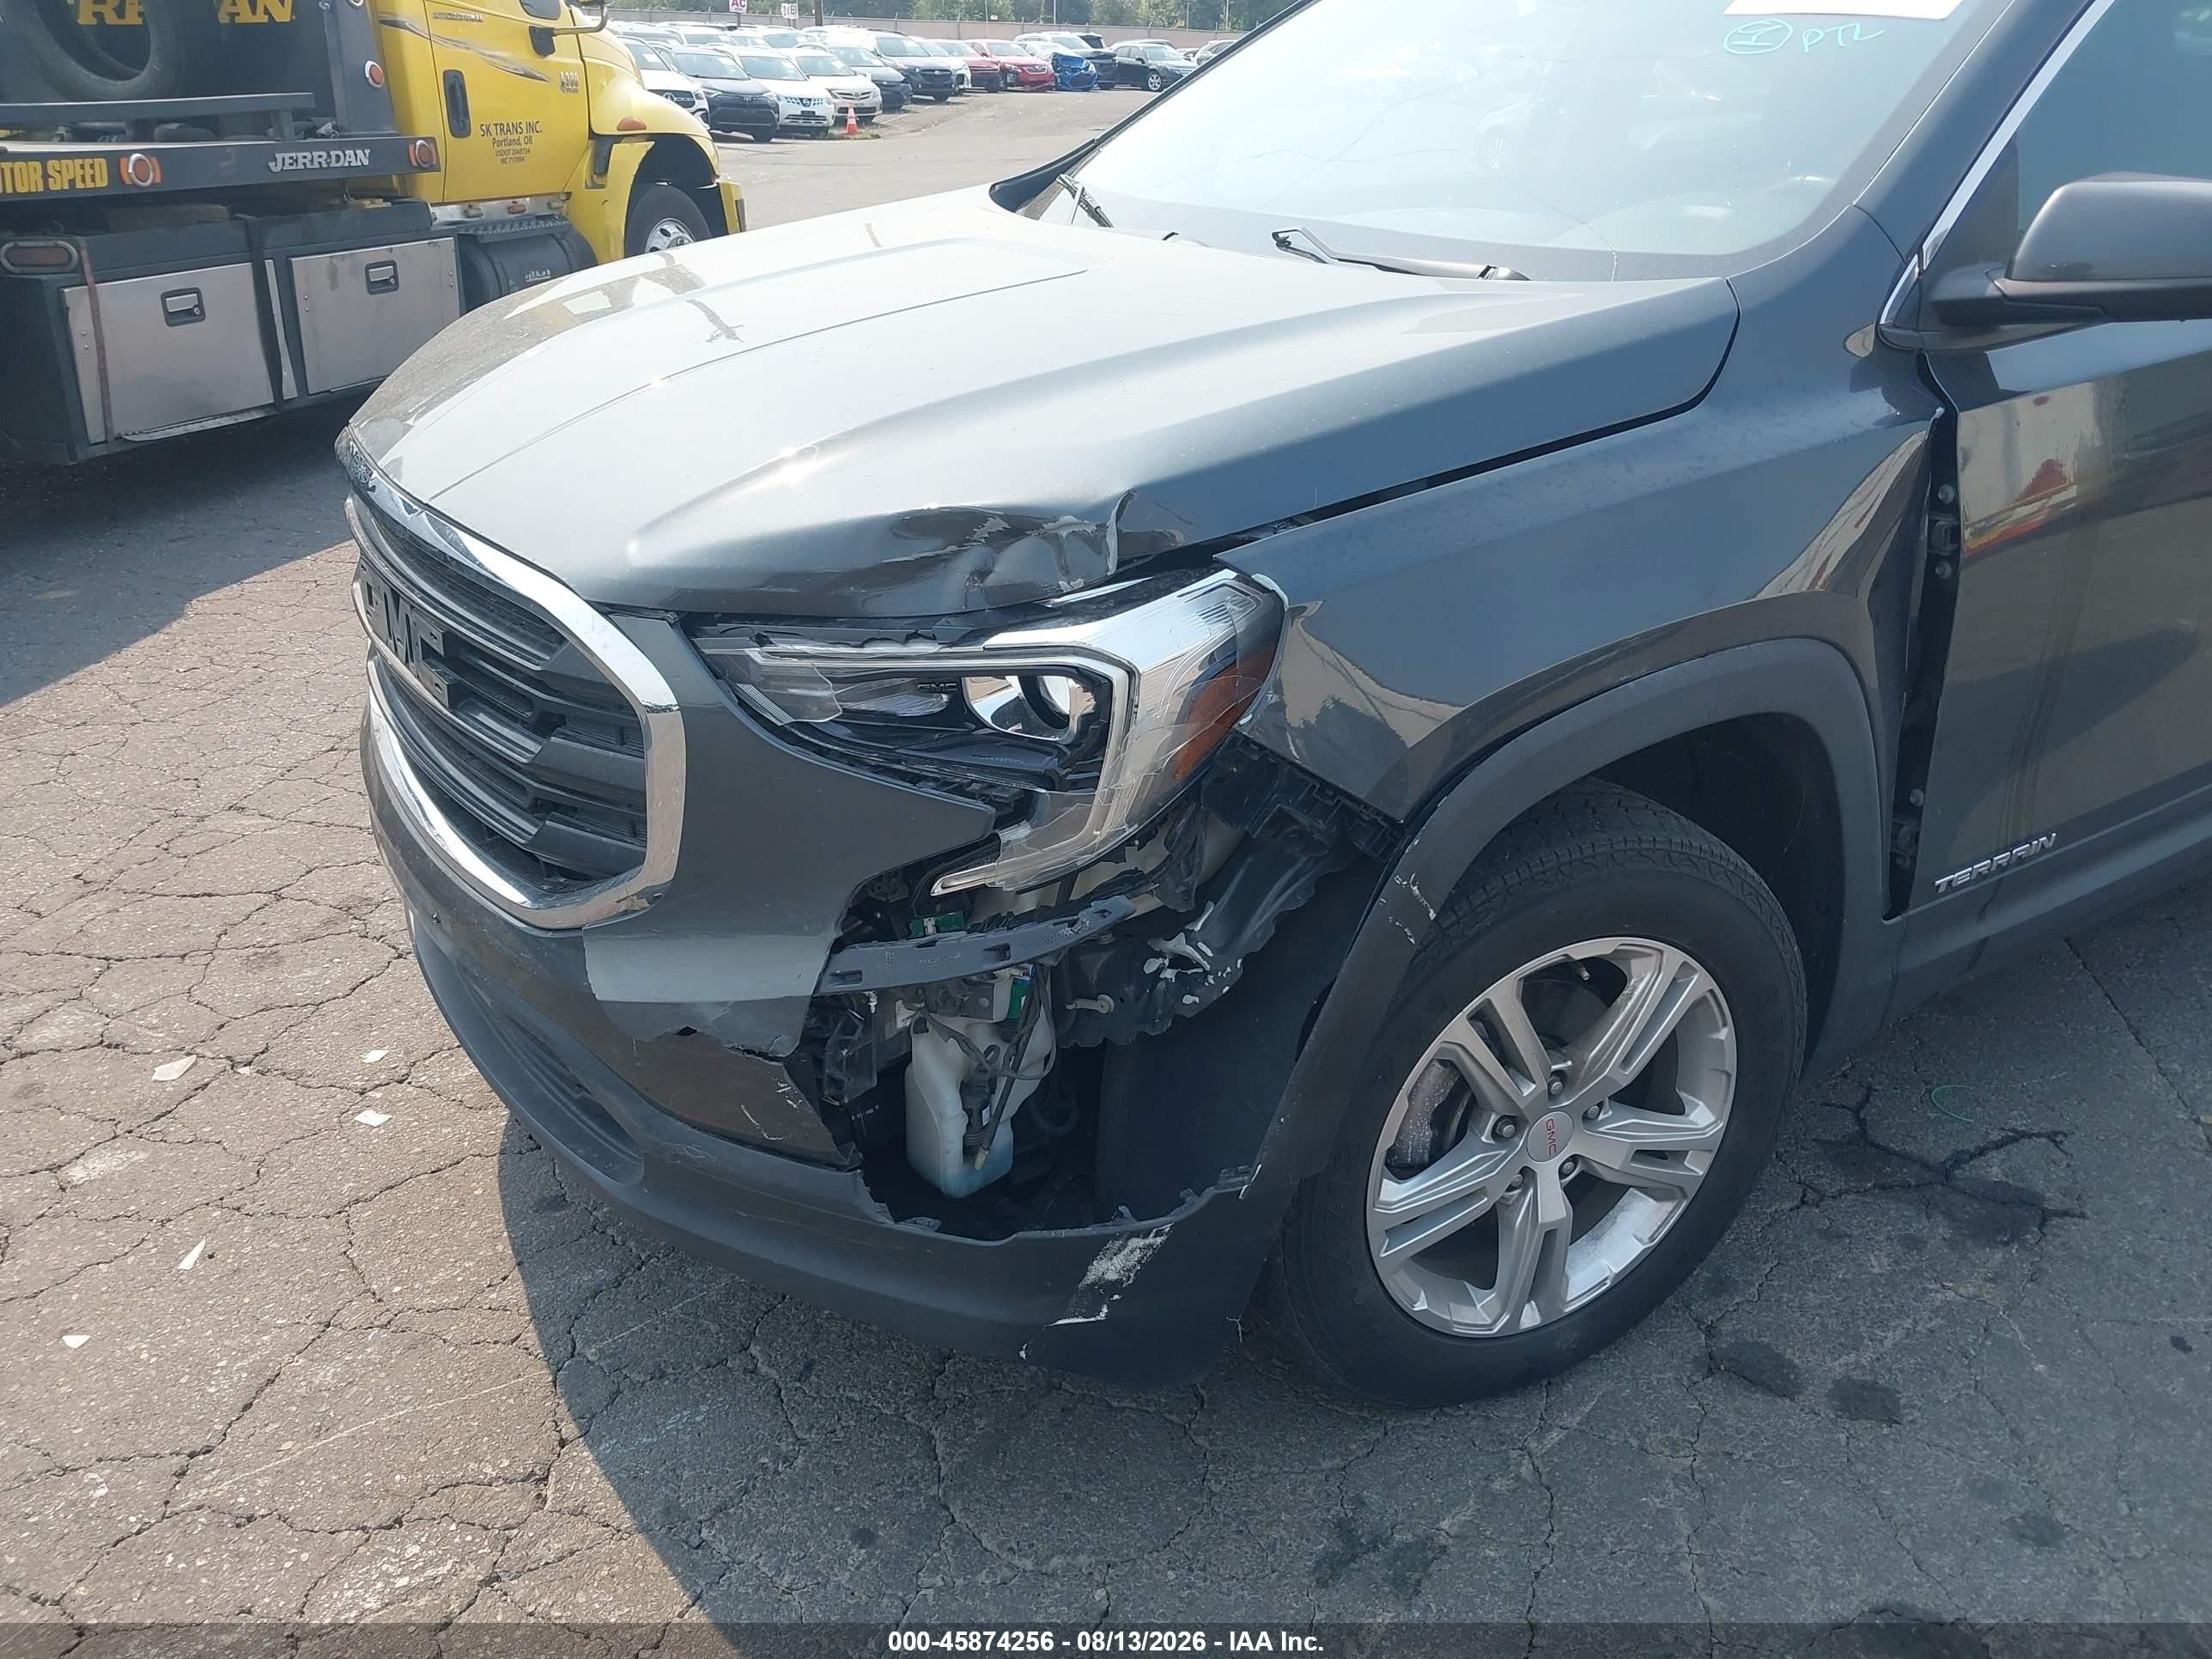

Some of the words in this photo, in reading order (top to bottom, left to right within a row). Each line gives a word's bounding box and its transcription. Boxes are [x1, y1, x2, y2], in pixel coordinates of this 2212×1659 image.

[480, 124, 492, 137] SK
[494, 122, 523, 136] TRANS
[526, 120, 543, 134] INC.
[492, 137, 522, 148] Portland,
[524, 136, 533, 145] OR
[0, 161, 44, 193] TOR
[46, 158, 108, 191] SPEED
[1934, 832, 2057, 893] TERRAIN
[1546, 1118, 1557, 1157] GMC
